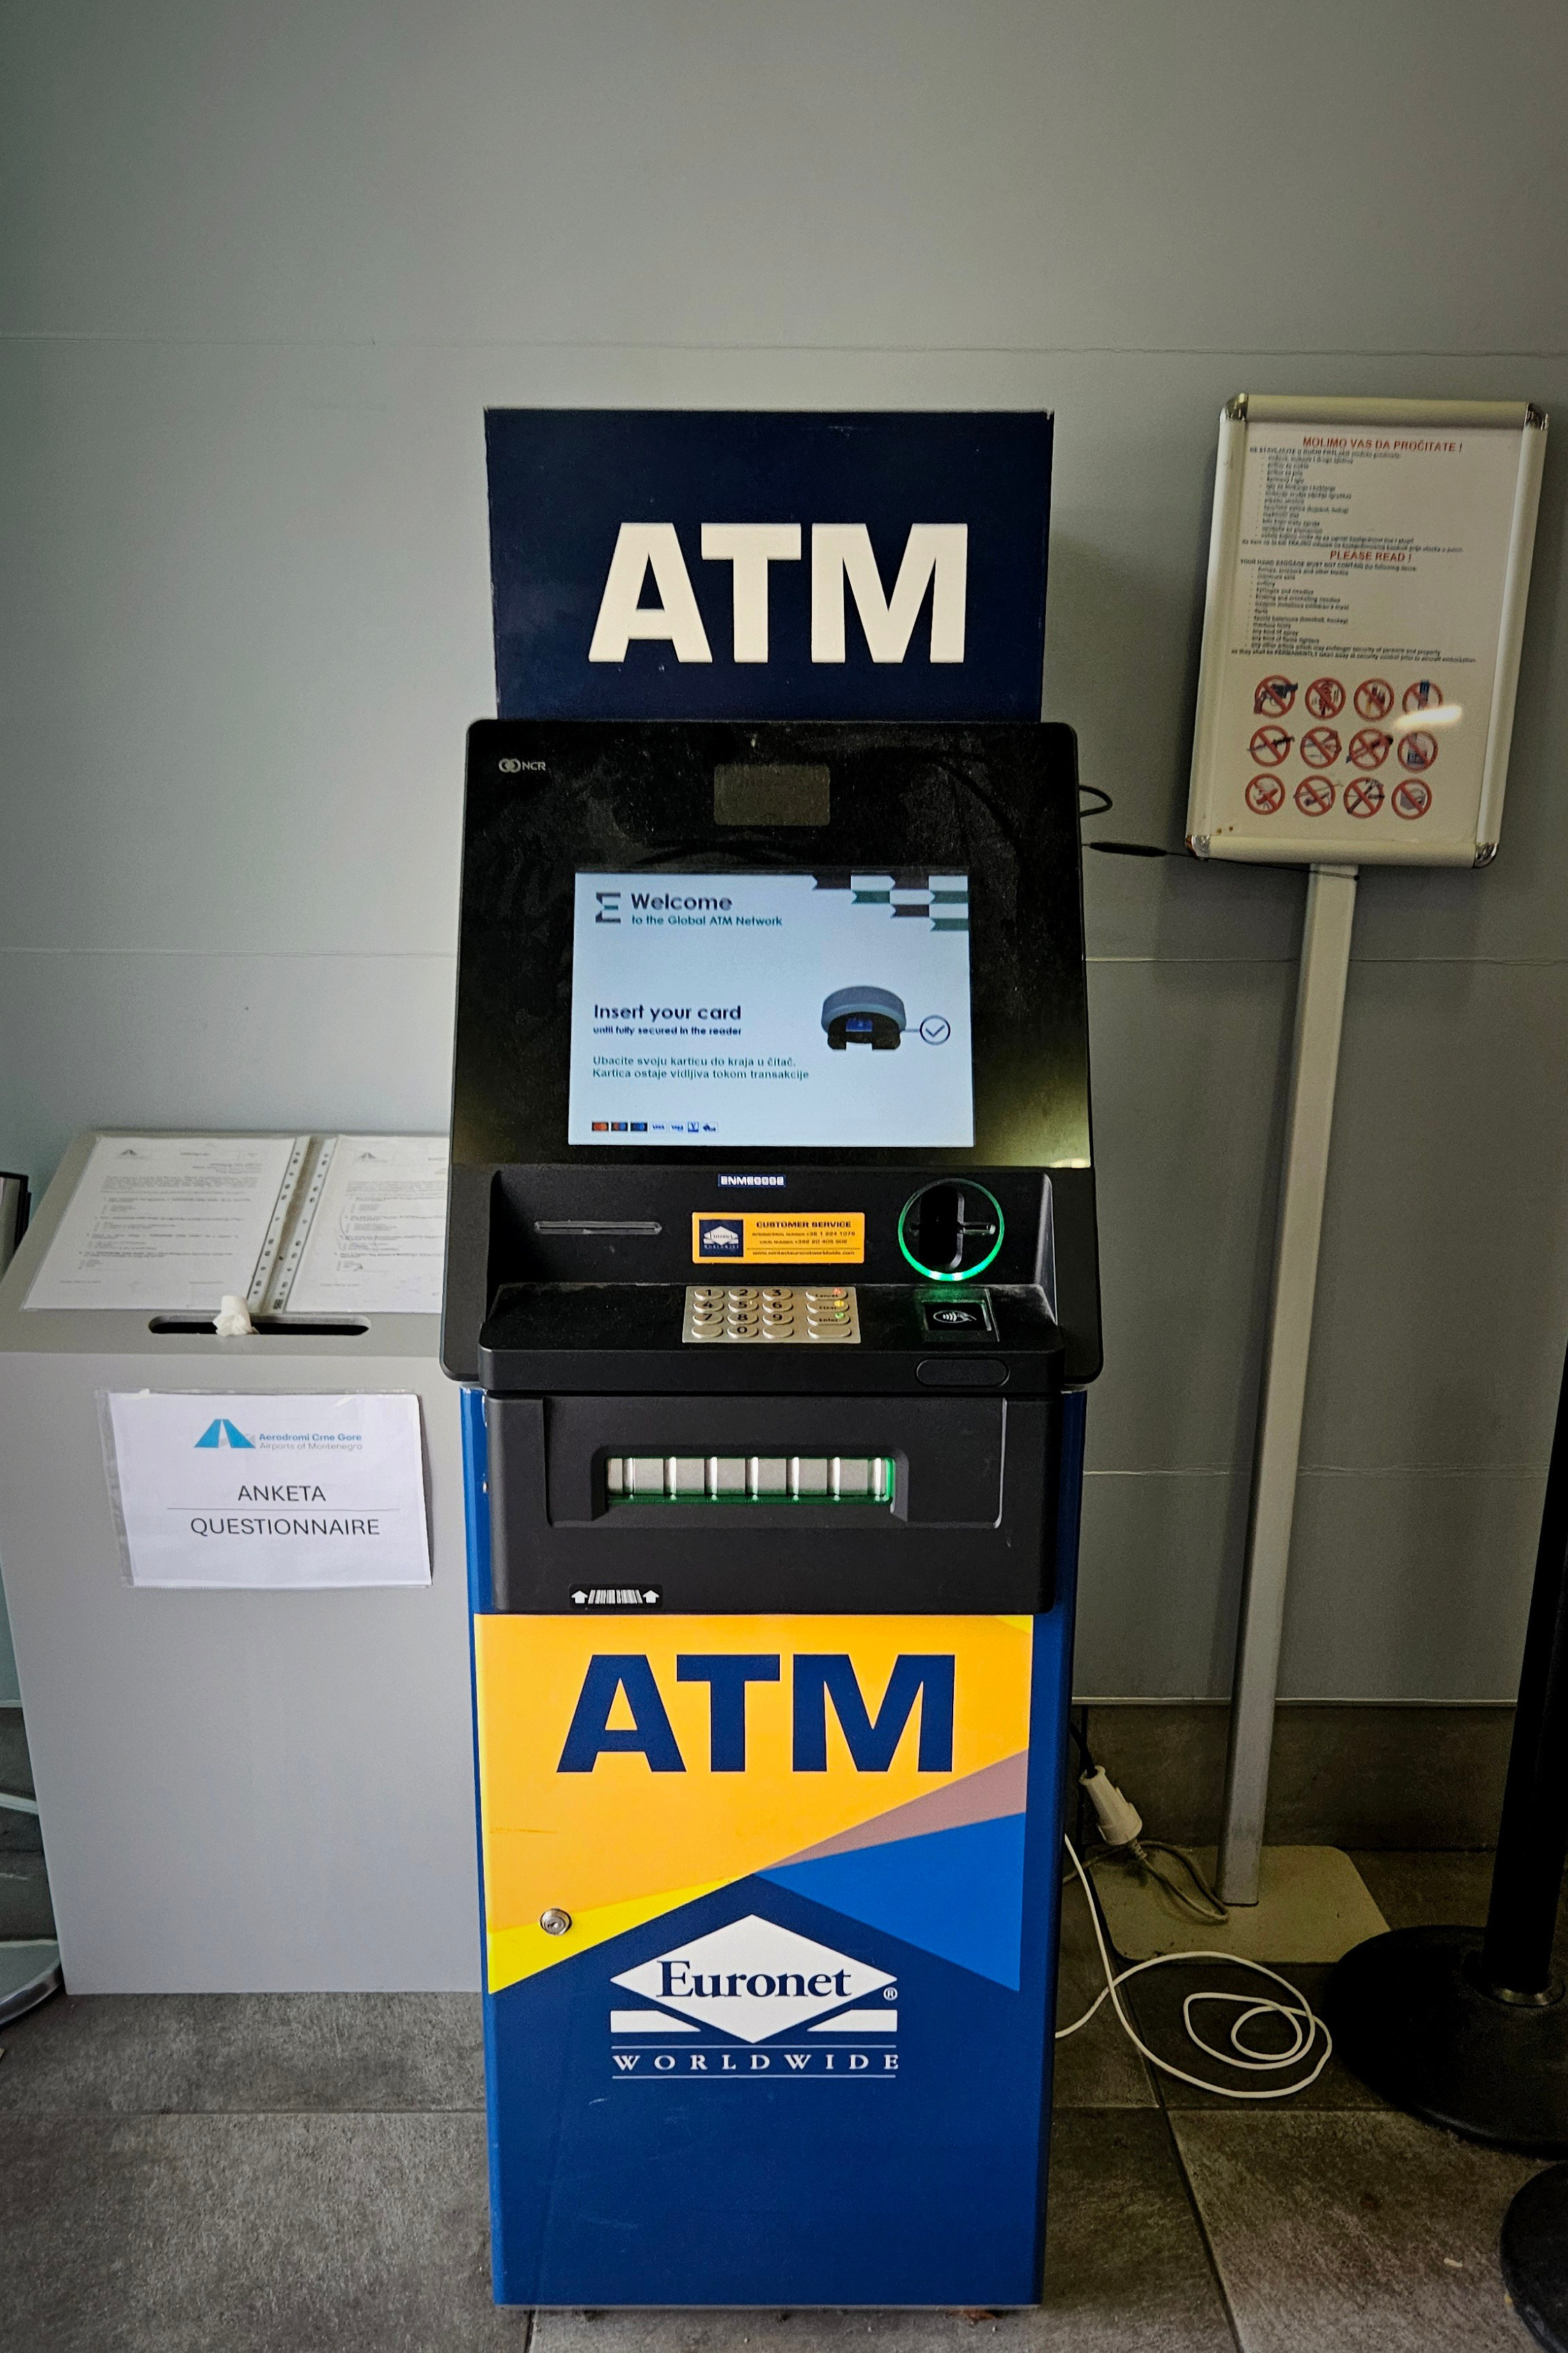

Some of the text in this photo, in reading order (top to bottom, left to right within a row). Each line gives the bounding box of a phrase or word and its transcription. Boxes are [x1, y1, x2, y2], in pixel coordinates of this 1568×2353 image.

[1303, 437, 1347, 448] MOLIMO
[1350, 439, 1372, 448] VAS
[1375, 439, 1390, 450] DA
[1393, 439, 1456, 452] PROČITATE
[1330, 550, 1372, 561] PLEASE
[1375, 552, 1405, 562] READ
[588, 522, 968, 663] ATM
[522, 761, 546, 771] NCR
[631, 893, 732, 911] Welcome
[632, 915, 782, 927] to the Global ATM Network
[594, 1004, 742, 1023] Insert your card
[593, 1026, 742, 1036] until fully secured in the reader
[593, 1056, 634, 1066] Ubacite
[637, 1057, 667, 1068] svoju
[671, 1057, 707, 1067] karticu
[710, 1056, 725, 1066] do
[728, 1057, 754, 1068] kraja
[593, 1069, 809, 1081] Kartica ostaje vidljiva tokom transakcije
[259, 1432, 362, 1441] Aerodromi Crne Gore
[260, 1443, 295, 1451] Airports
[308, 1443, 362, 1452] Montenegro
[237, 1485, 326, 1501] ANKETA
[191, 1517, 380, 1537] QUESTIONNAIRE
[557, 1654, 955, 1772] ATM
[656, 1961, 852, 1998] Euronet
[612, 2054, 899, 2071] WORLDWIDE
